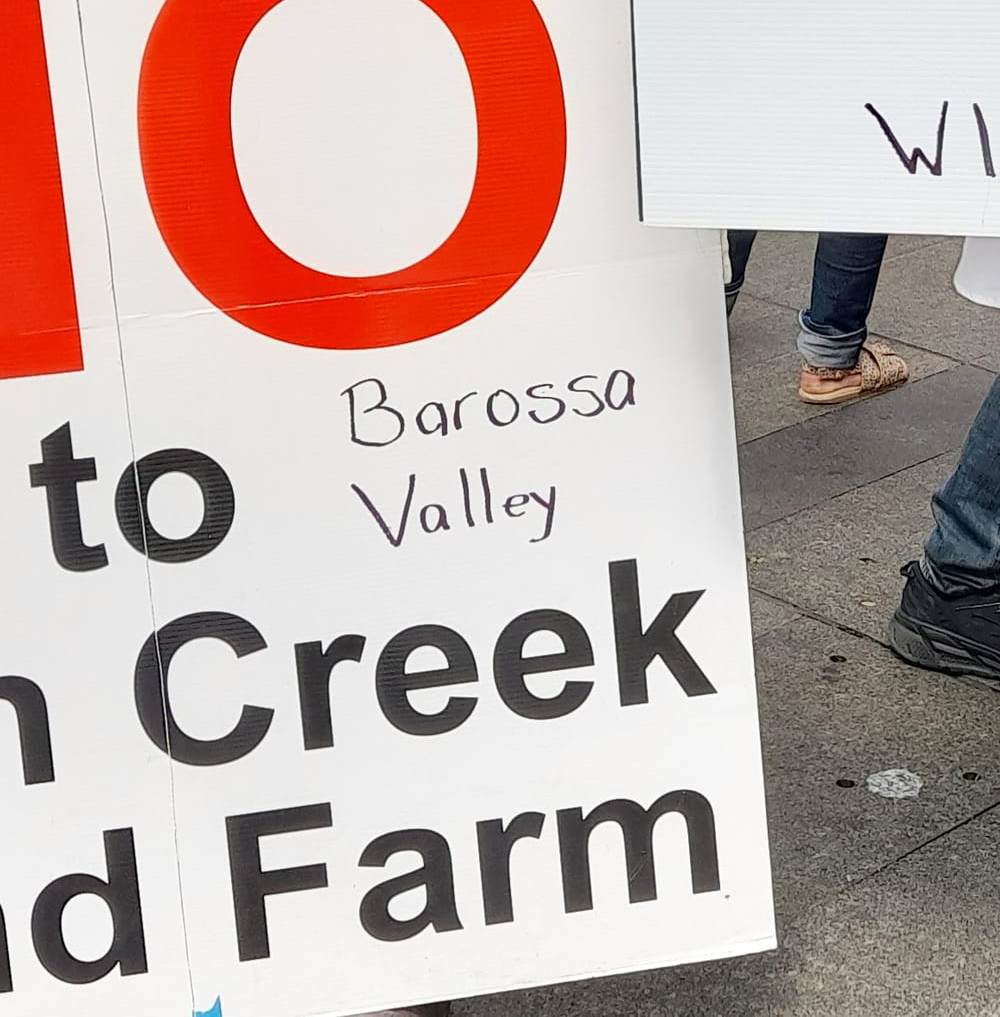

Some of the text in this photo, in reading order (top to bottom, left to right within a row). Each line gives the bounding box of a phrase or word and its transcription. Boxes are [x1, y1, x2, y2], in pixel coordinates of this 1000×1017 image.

[341, 370, 637, 447] Barossa
[29, 421, 235, 572] to
[351, 467, 557, 547] Valley
[134, 559, 717, 766] Creek
[226, 789, 721, 962] Farm
